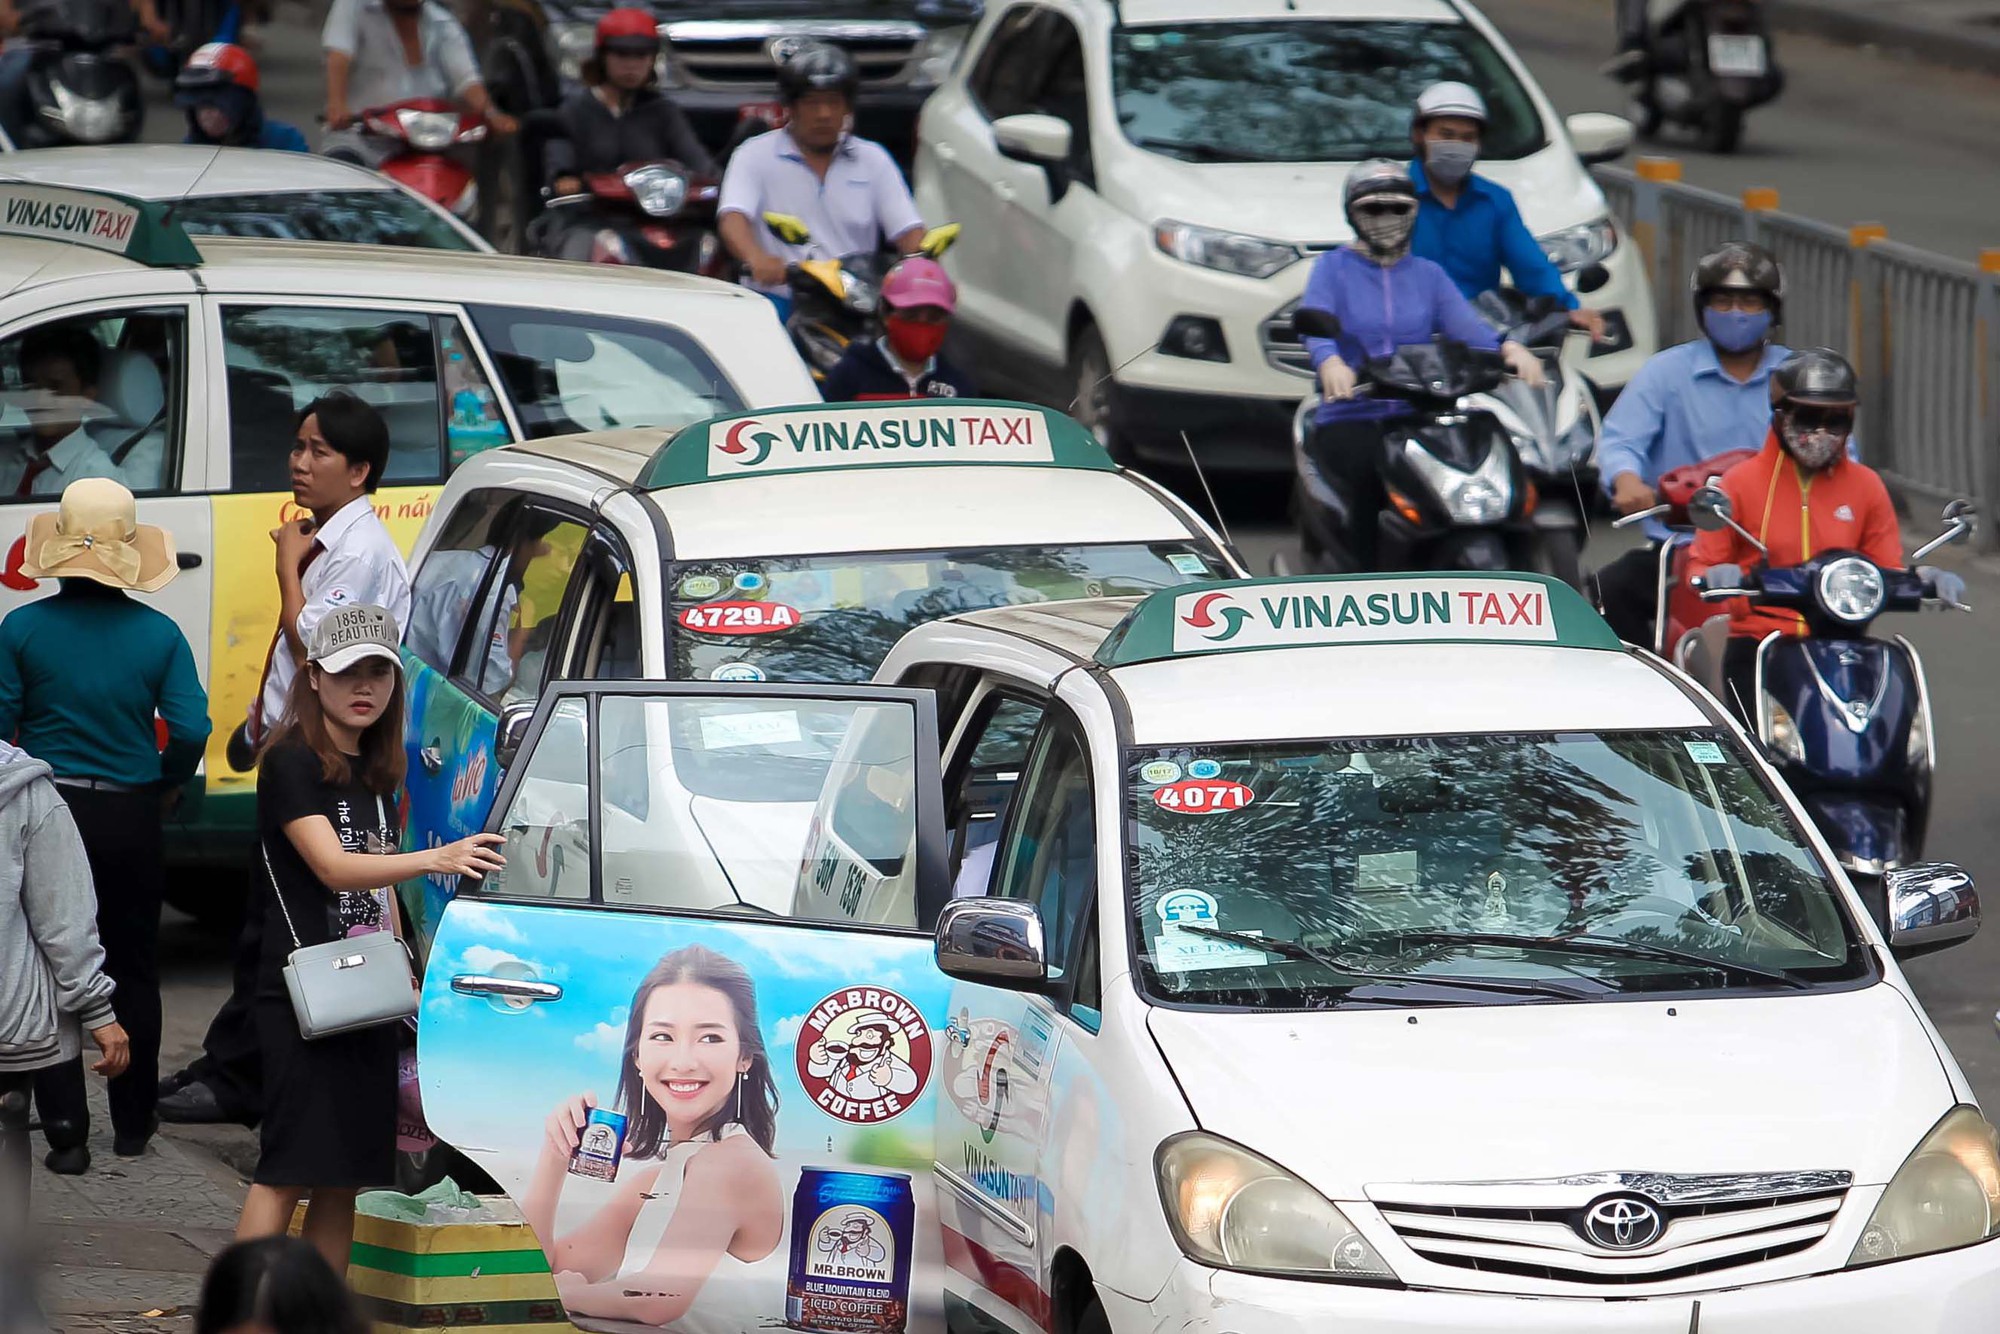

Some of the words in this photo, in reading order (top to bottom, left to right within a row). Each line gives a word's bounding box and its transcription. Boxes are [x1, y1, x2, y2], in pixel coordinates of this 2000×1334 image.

[6, 197, 94, 233] VINASUN
[92, 208, 132, 240] TAXI
[785, 418, 956, 452] VINASUN
[960, 417, 1032, 446] TAXI
[685, 605, 793, 627] 4729.A
[1261, 591, 1451, 629] VINASUN
[1458, 591, 1543, 626] TAXI
[1160, 786, 1245, 807] 4071
[338, 800, 351, 824] the
[340, 827, 360, 852] roll
[816, 1088, 902, 1120] COFFEE
[963, 1140, 1009, 1202] VINASUN
[806, 1281, 824, 1293] BLUE
[825, 1283, 866, 1297] MOUNTAIN
[867, 1288, 890, 1299] BLEND
[810, 1298, 837, 1310] ICED
[840, 1301, 883, 1314] COFFEE
